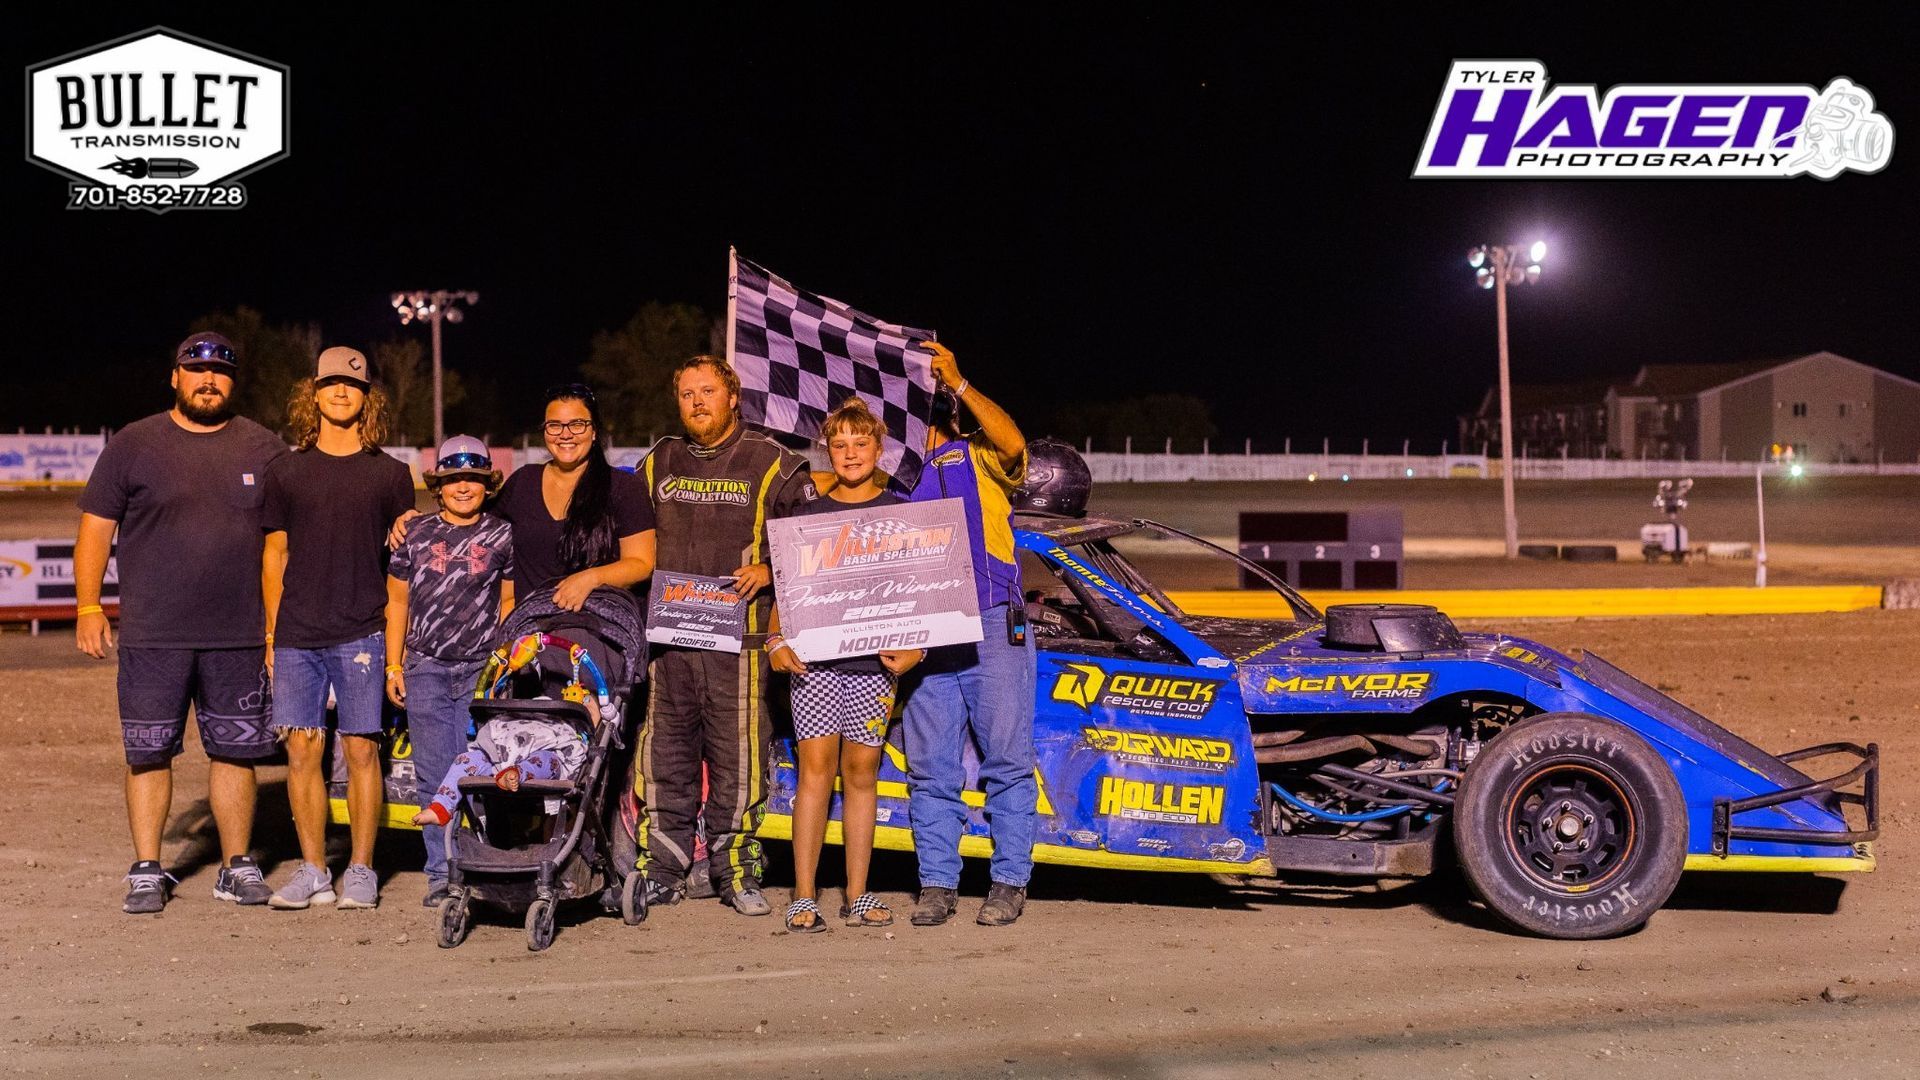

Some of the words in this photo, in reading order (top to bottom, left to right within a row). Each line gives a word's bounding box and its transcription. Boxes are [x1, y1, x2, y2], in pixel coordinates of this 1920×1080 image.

[678, 478, 748, 494] EVOLUTION
[675, 489, 748, 503] COMPLETIONS
[799, 523, 952, 577] WILLISTON
[843, 554, 880, 566] BASIN
[884, 545, 948, 562] SPEEDWAY
[1261, 545, 1270, 559] 1
[1315, 545, 1325, 559] 2
[1370, 545, 1380, 559] 3
[1048, 547, 1106, 587] Thomte
[786, 585, 869, 611] Feature
[871, 575, 965, 599] Winner
[653, 605, 693, 619] Feature
[694, 613, 738, 625] Winner
[841, 601, 917, 621] 2022
[677, 622, 715, 632] 2022
[842, 623, 893, 634] WILLISTON
[897, 619, 922, 628] AUTO
[671, 636, 716, 648] MODIFIED
[838, 630, 930, 654] MODIFIED
[1109, 675, 1217, 702] QUICK
[1265, 673, 1430, 692] McIVOR
[1352, 688, 1421, 698] FARMS
[1102, 695, 1164, 708] rescue
[1168, 701, 1210, 712] roof
[1100, 776, 1223, 824] HOLLEN
[1123, 810, 1157, 820] AUTO
[1162, 813, 1195, 823] BODY
